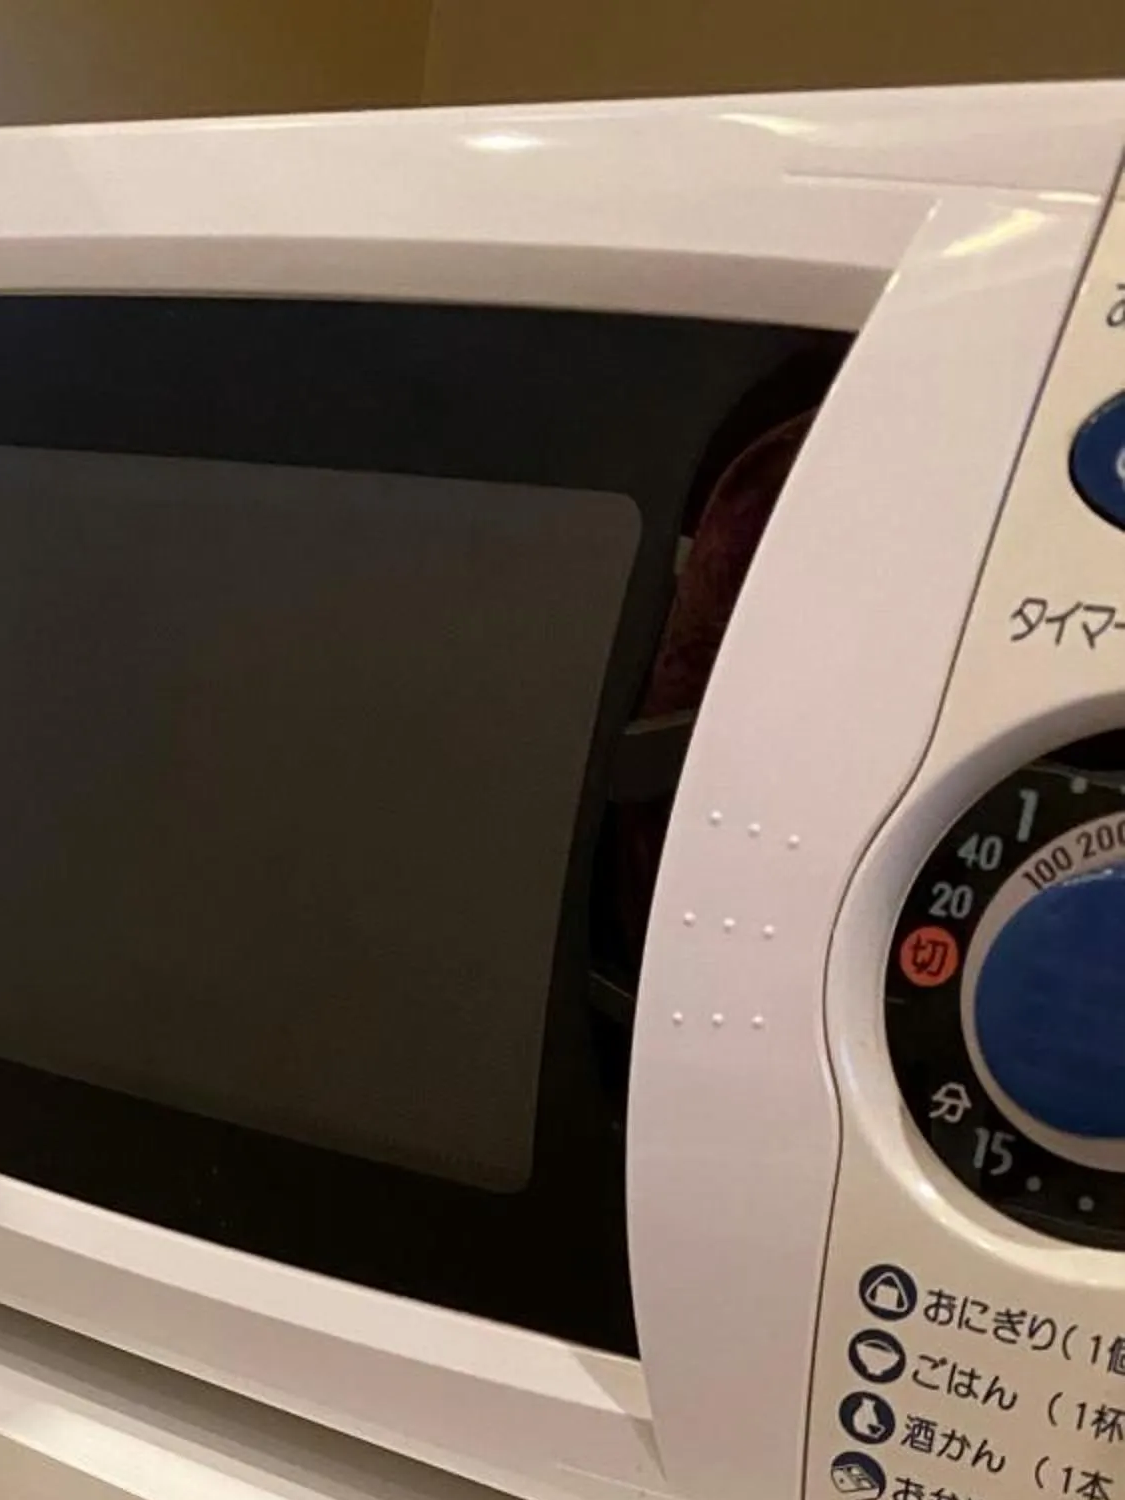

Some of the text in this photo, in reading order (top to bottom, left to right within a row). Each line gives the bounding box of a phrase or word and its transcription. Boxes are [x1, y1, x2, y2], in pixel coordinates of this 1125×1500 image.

[1017, 788, 1039, 842] 1
[957, 833, 1003, 872] 40
[1022, 846, 1073, 890] 100
[928, 881, 973, 919] 20
[911, 934, 949, 977] 切
[928, 1081, 971, 1123] 分
[973, 1126, 1015, 1176] 15
[911, 1354, 1018, 1411] ごはん
[900, 1414, 1006, 1473] 酒かん
